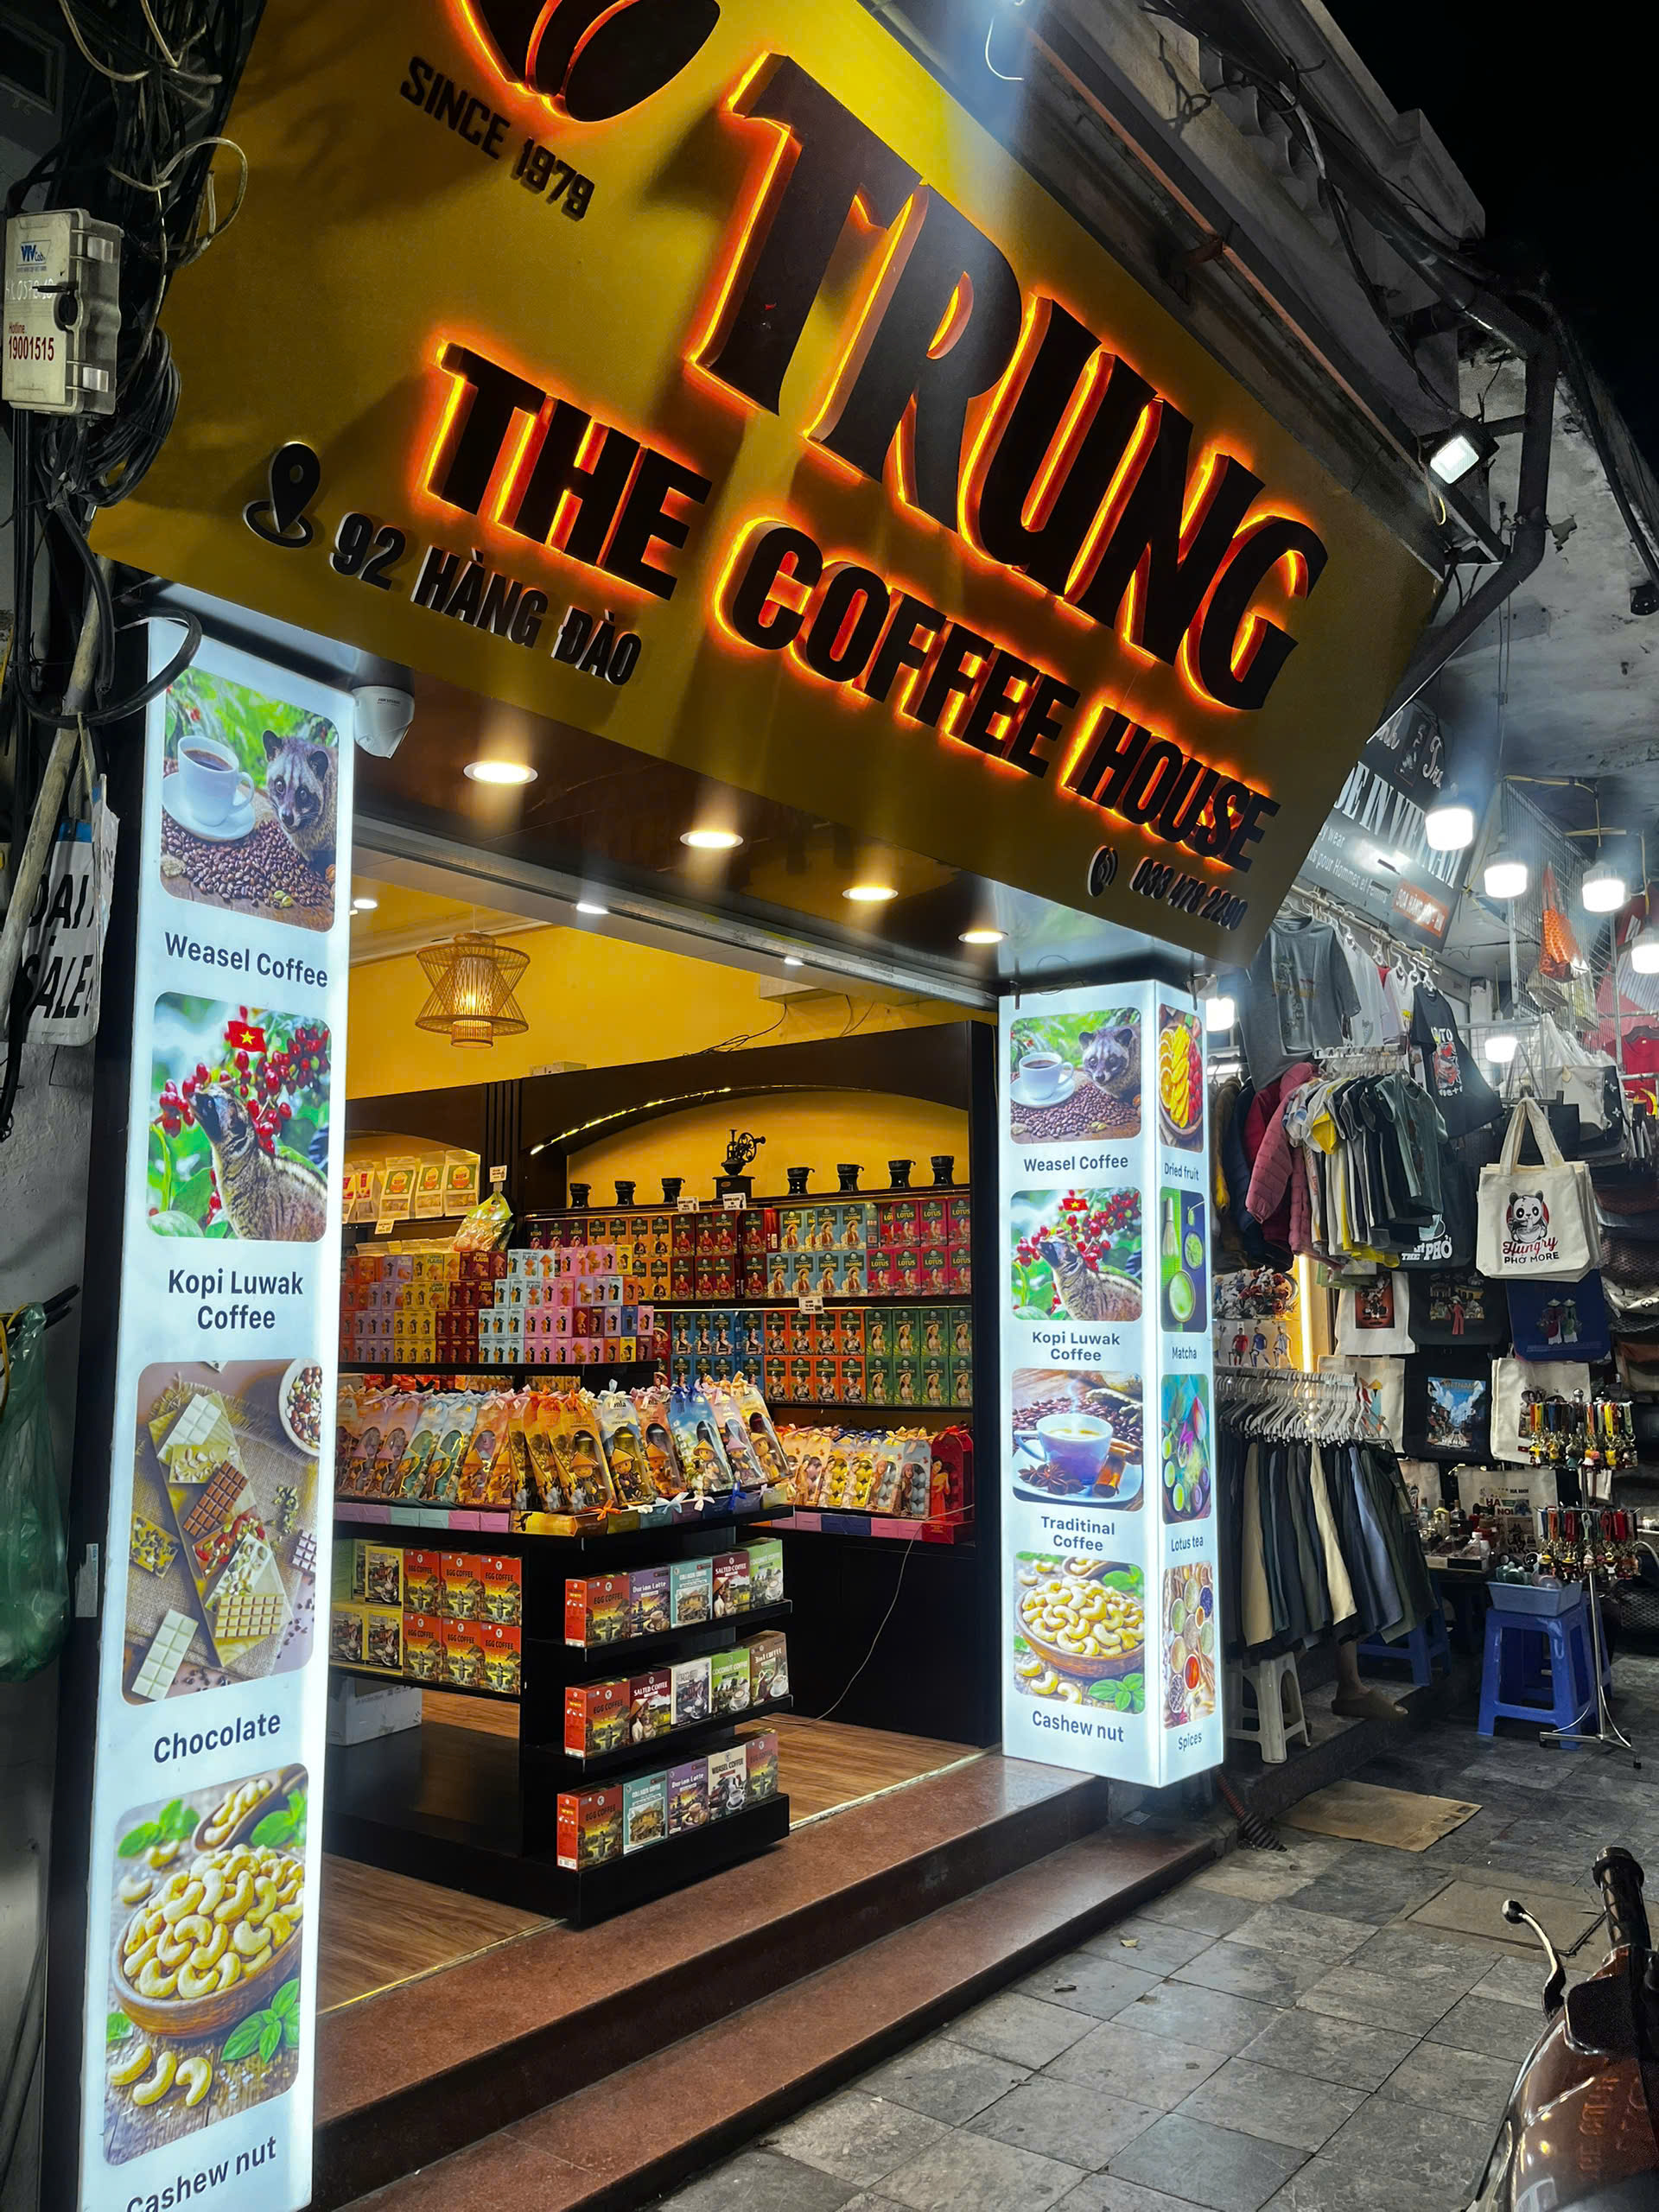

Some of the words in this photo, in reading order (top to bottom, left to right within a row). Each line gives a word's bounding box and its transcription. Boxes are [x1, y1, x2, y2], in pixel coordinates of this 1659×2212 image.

[400, 56, 511, 160] SINCE
[511, 137, 594, 221] 1979
[9, 336, 54, 361] 19001515
[685, 52, 1329, 710] TRUNG
[330, 511, 406, 591] 92
[410, 544, 549, 649] HÀNG
[551, 605, 642, 686] ĐÀO
[427, 342, 713, 601] THE
[716, 519, 1081, 779] COFFEE
[1062, 706, 1281, 873] HOUSE
[1328, 829, 1345, 849] wear
[1316, 852, 1334, 870] pour
[1129, 857, 1175, 899] 033
[164, 932, 251, 971] Weasel
[257, 946, 329, 988] Coffee
[1024, 1156, 1075, 1173] Weasel
[1079, 1154, 1128, 1170] Coffee
[1163, 1162, 1183, 1178] Dried
[1184, 1166, 1199, 1181] fruit
[1503, 1236, 1559, 1256] Hungry
[1530, 1251, 1560, 1262] MORE
[168, 1268, 224, 1299] Kopi
[231, 1270, 303, 1296] Luwak
[197, 1304, 276, 1330] Coffee
[1033, 1332, 1065, 1346] Kopi
[1071, 1332, 1121, 1345] Luwak
[1051, 1348, 1102, 1362] Coffee
[1172, 1346, 1198, 1360] Matcha
[1041, 1516, 1116, 1535] Traditinal
[1053, 1535, 1104, 1552] Coffee
[1171, 1538, 1192, 1553] Lotus
[1192, 1535, 1204, 1548] tea
[731, 1563, 747, 1572] COFFEE
[632, 1585, 652, 1593] Durian
[652, 1581, 666, 1590] Latte
[633, 1687, 652, 1697] SALTED
[652, 1681, 668, 1691] COFFEE
[1033, 1710, 1093, 1737] Cashew
[1097, 1726, 1125, 1743] nut
[153, 1713, 282, 1764] Chocolate
[1178, 1732, 1203, 1751] Spices
[728, 1758, 744, 1769] COFFEE
[671, 1777, 690, 1789] Durian
[690, 1773, 704, 1782] Latte
[126, 2160, 230, 2212] Cashew
[236, 2135, 277, 2176] nut
